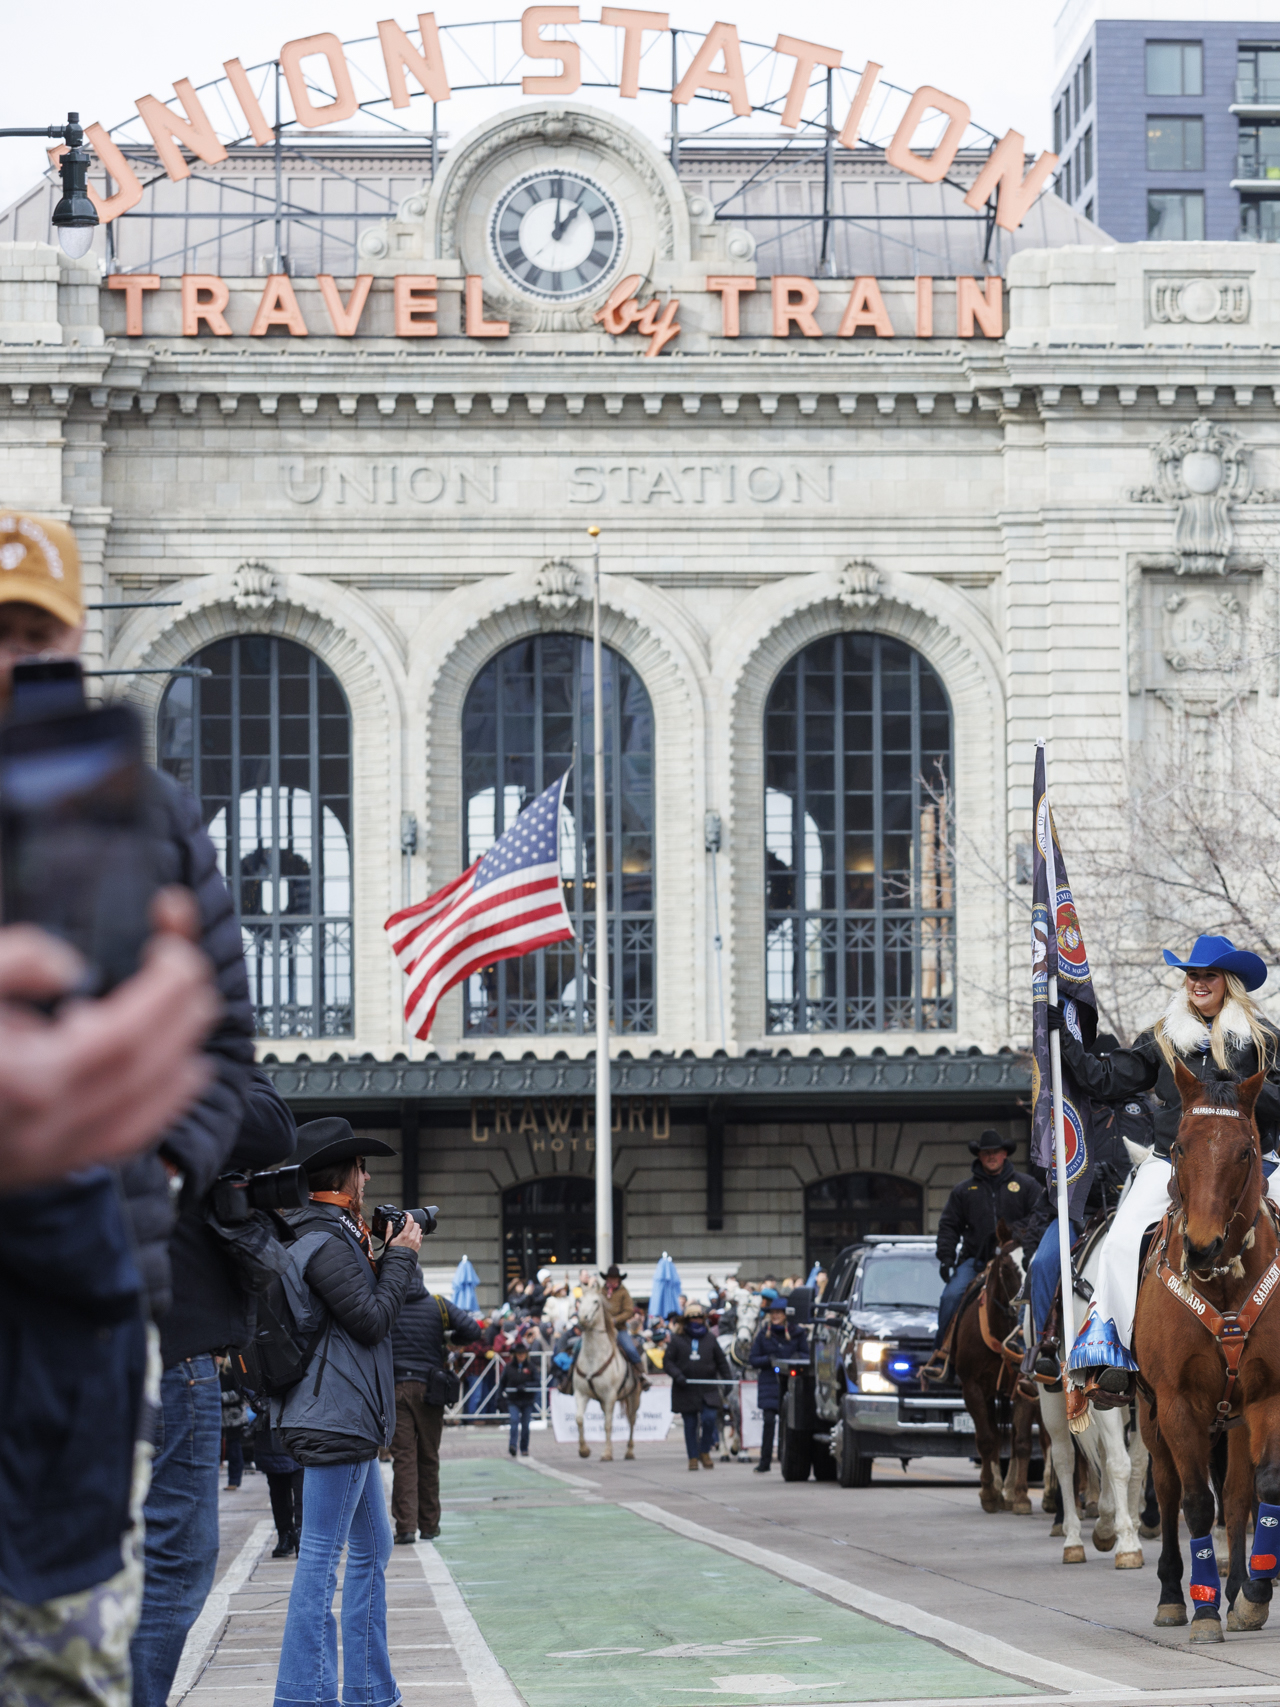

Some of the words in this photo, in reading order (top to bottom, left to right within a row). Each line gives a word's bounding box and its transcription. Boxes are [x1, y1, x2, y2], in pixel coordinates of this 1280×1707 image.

[48, 12, 451, 223] UNION
[521, 5, 1059, 232] STATION
[108, 274, 510, 337] TRAVEL
[593, 274, 681, 357] by
[706, 275, 1003, 338] TRAIN
[280, 463, 501, 505] UNION
[567, 463, 835, 505] STATION
[1192, 1107, 1216, 1115] COLORADO
[1215, 1108, 1240, 1118] SADDLERY
[532, 1138, 597, 1153] HOTE
[338, 1214, 362, 1238] SONY
[1167, 1274, 1206, 1316] COLOADO
